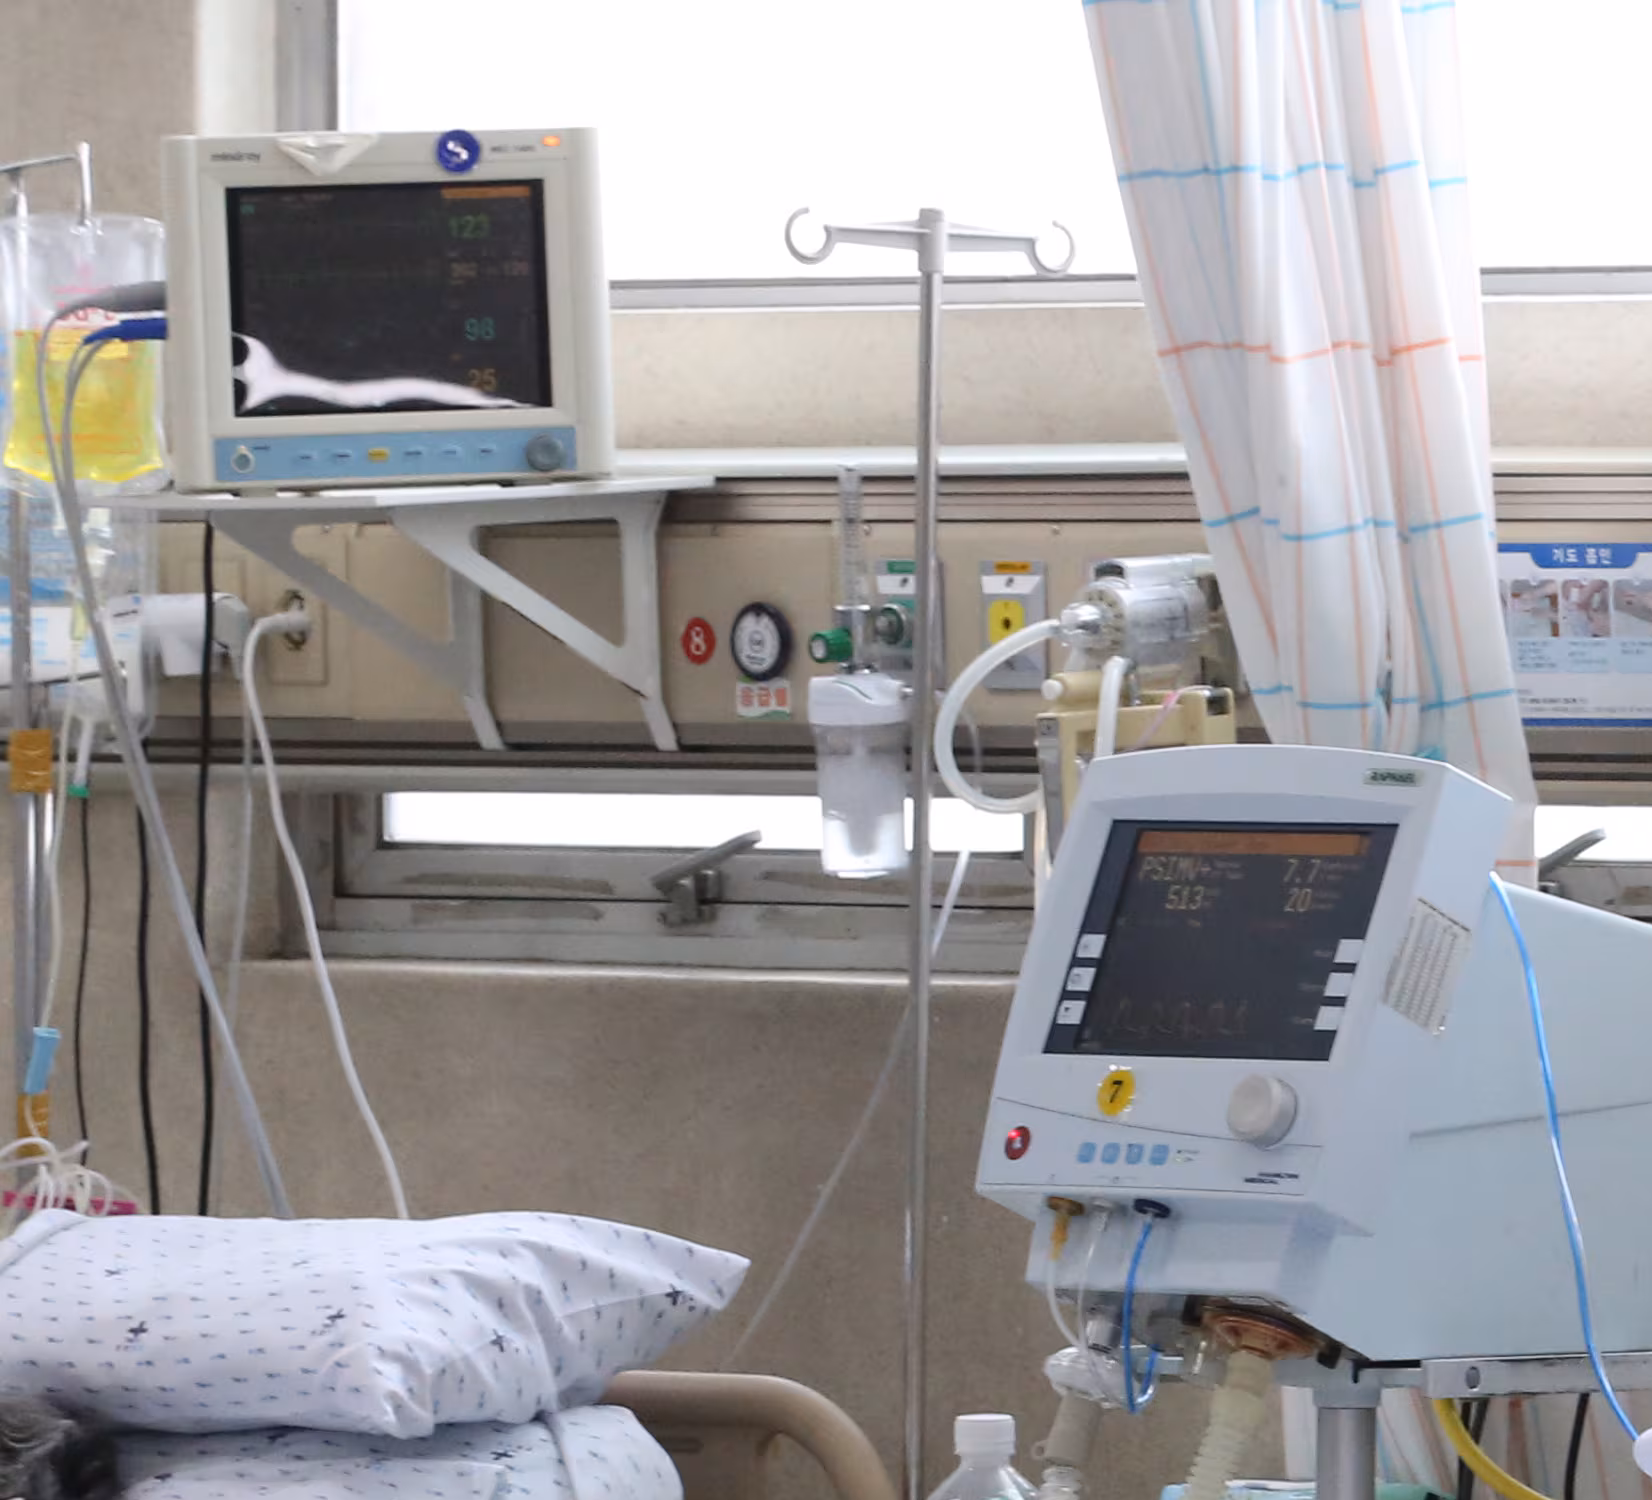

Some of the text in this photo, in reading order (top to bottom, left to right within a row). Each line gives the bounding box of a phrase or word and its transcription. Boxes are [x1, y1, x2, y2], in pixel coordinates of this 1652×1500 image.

[690, 625, 706, 656] 8
[1165, 885, 1206, 910] 513
[1284, 888, 1313, 913] 20
[1109, 1080, 1124, 1104] 7
